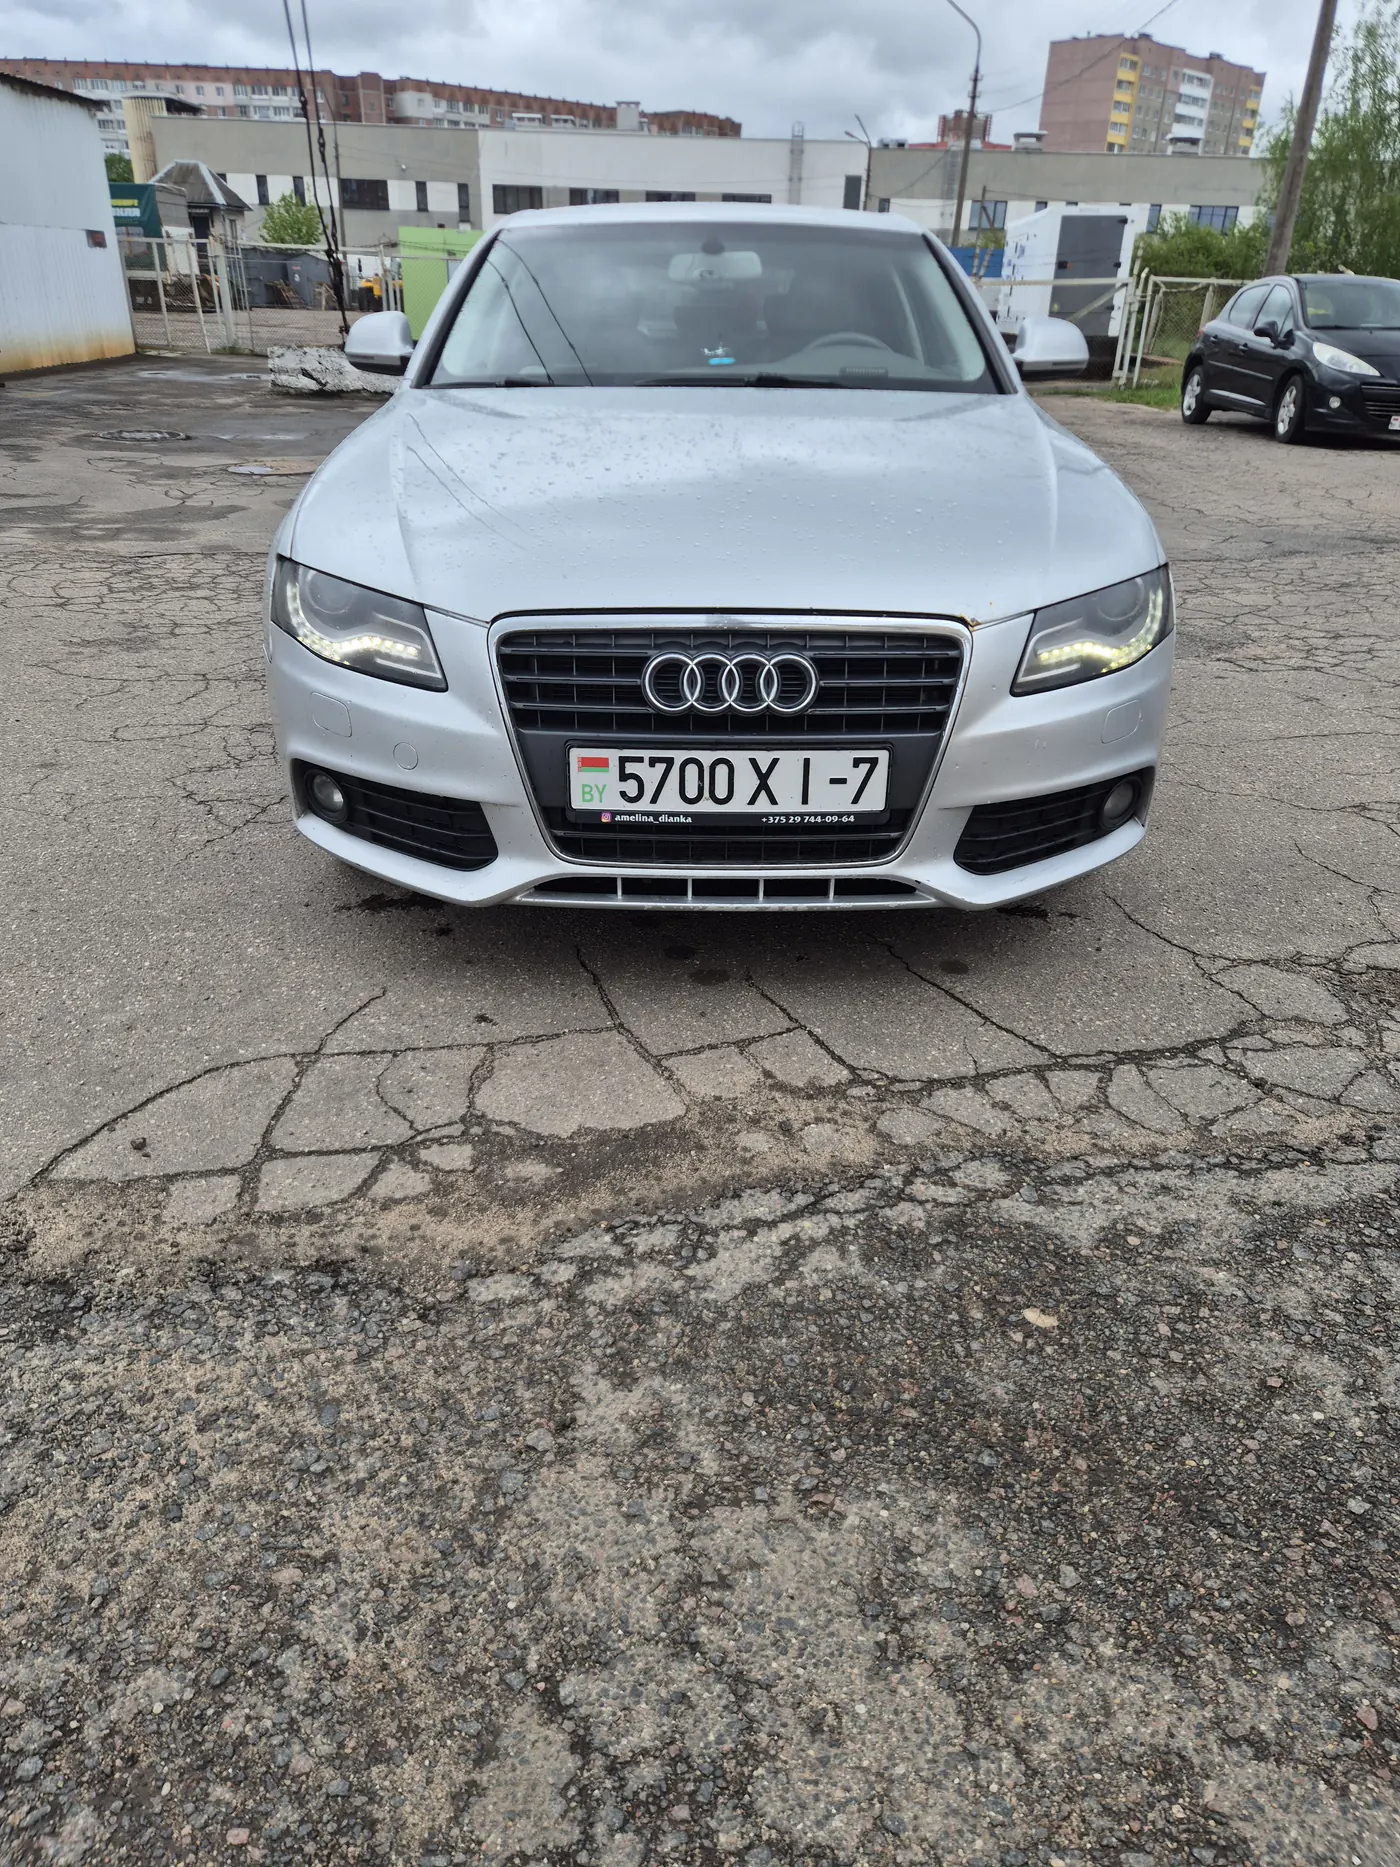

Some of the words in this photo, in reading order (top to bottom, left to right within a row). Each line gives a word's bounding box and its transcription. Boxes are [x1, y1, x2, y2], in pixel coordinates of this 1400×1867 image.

[618, 755, 735, 806] 5700
[581, 784, 607, 803] BY
[614, 813, 692, 824] amelina_dianka
[761, 815, 786, 824] +375
[788, 815, 801, 824] 29
[803, 814, 855, 824] 744-09-64
